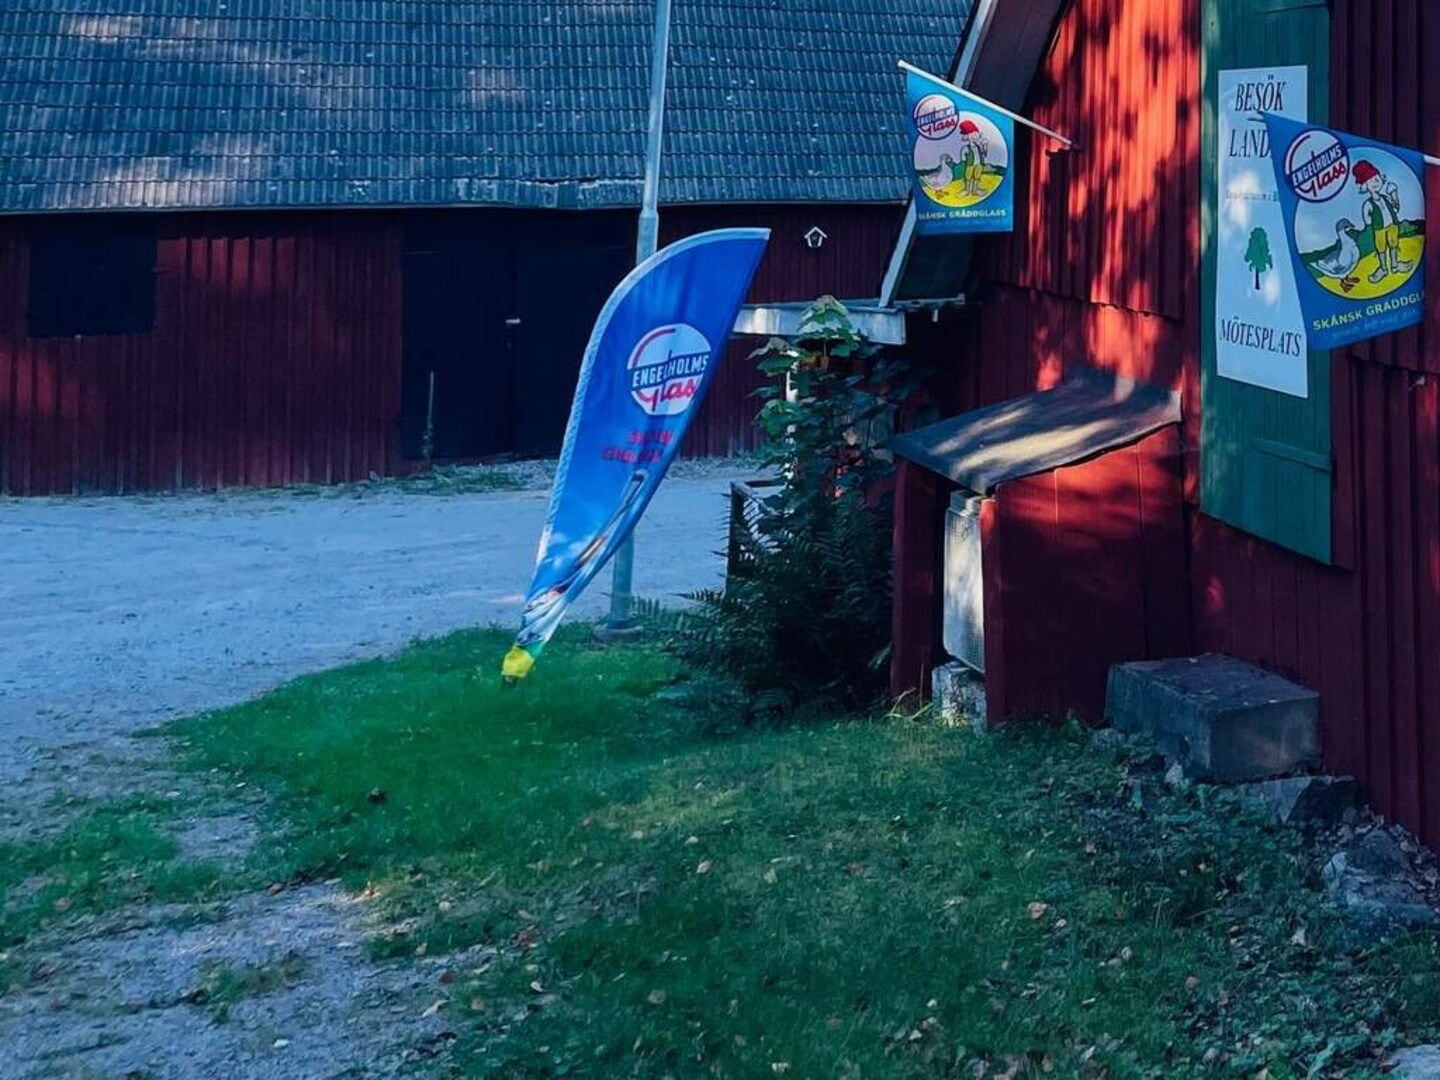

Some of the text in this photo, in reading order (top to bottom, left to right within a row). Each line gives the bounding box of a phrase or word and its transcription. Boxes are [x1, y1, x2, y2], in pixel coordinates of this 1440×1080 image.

[1234, 74, 1287, 112] BESÖK
[1220, 315, 1302, 358] MÖTESPLATS
[632, 354, 710, 388] ENGELHOLMS
